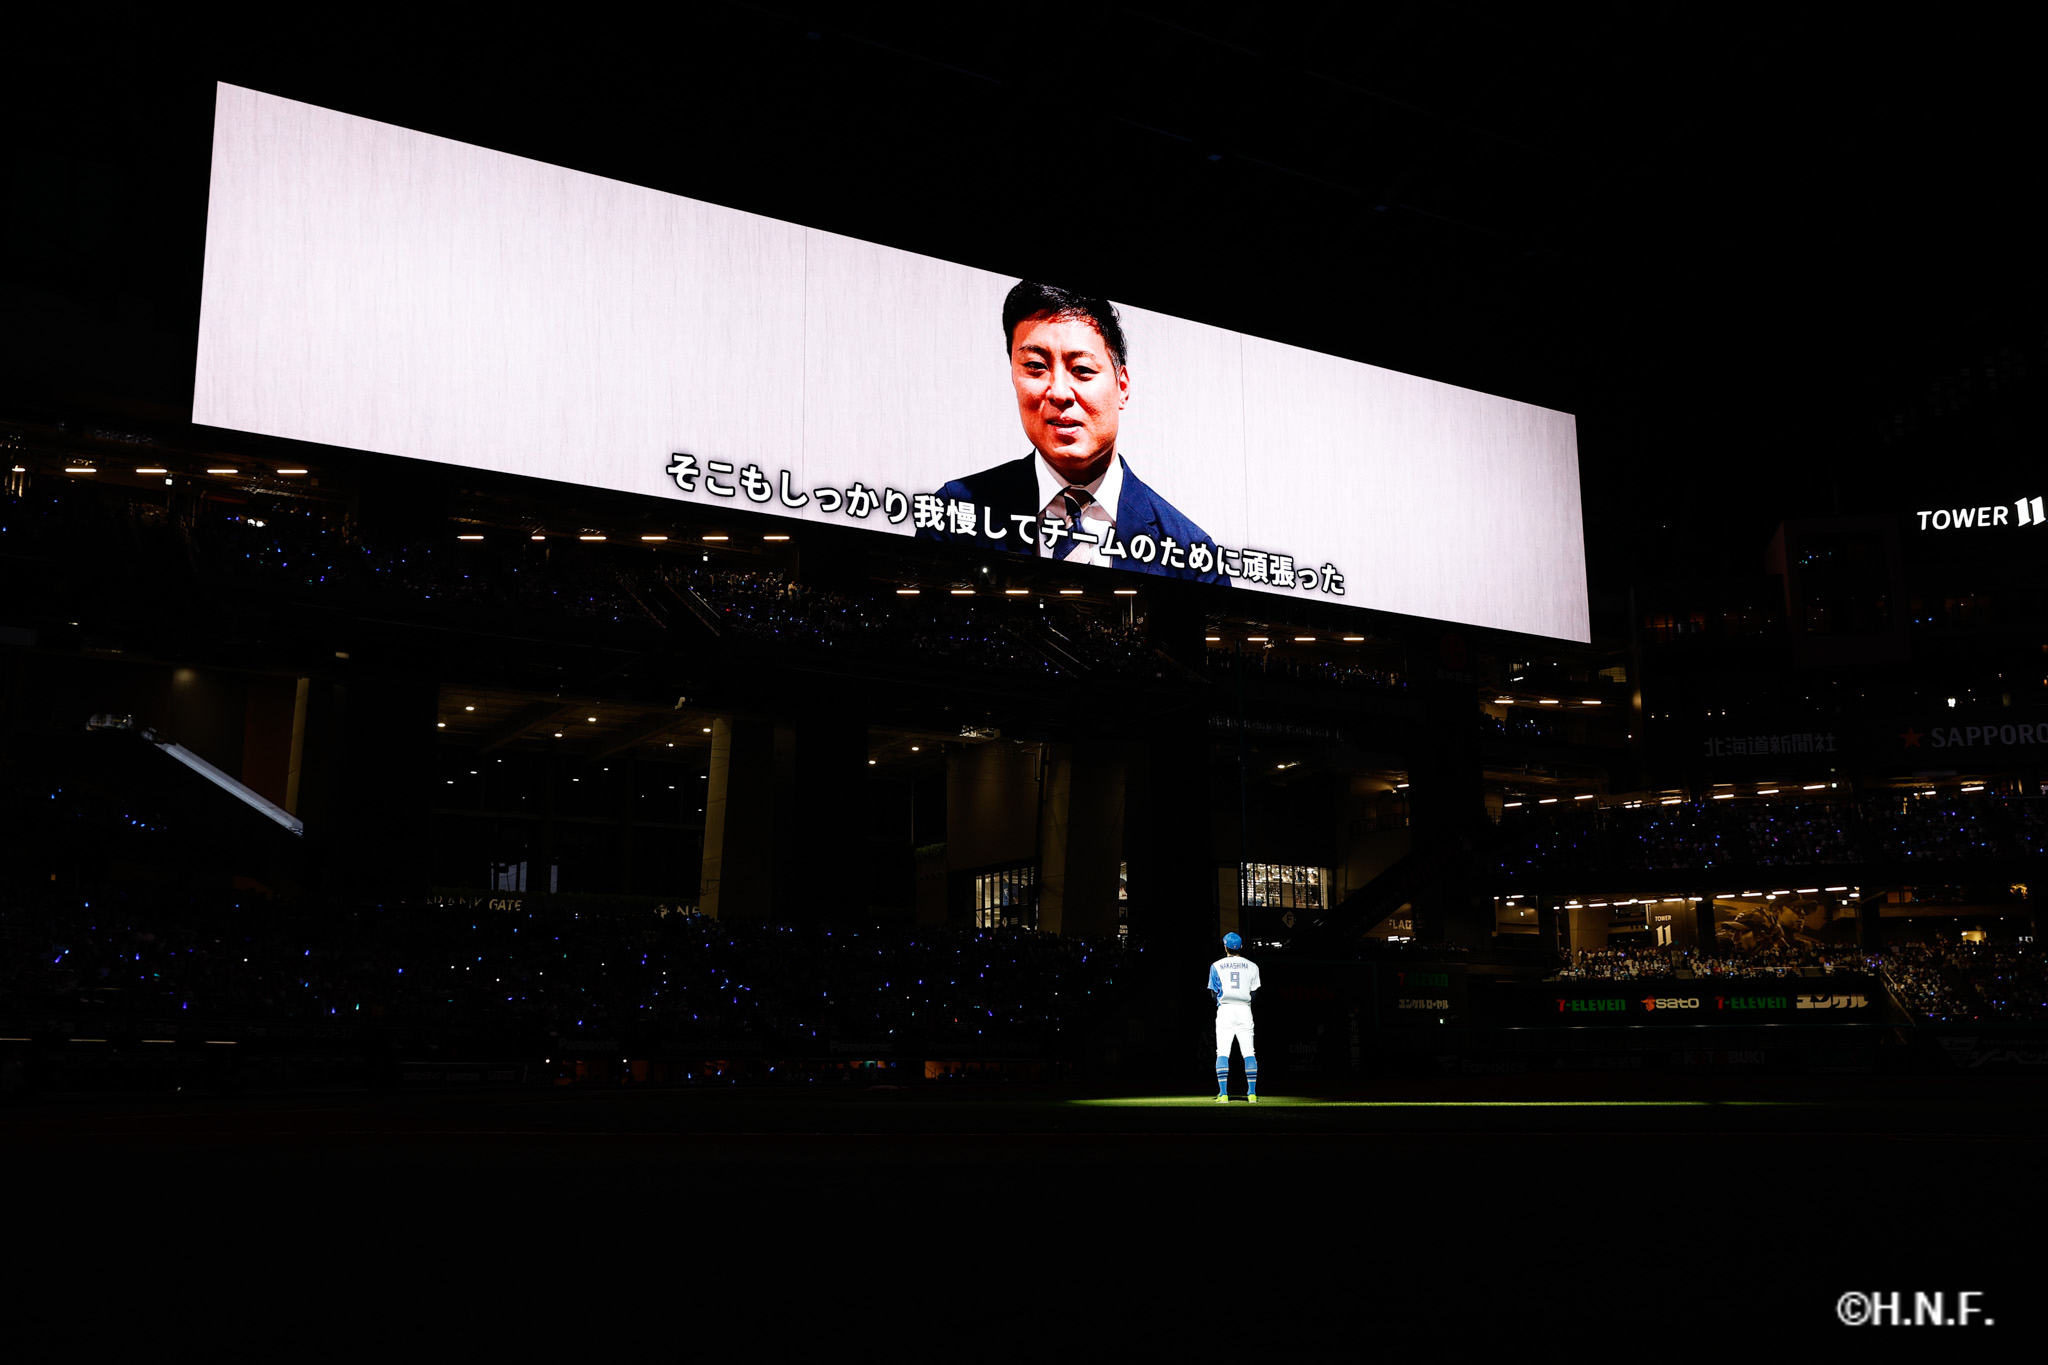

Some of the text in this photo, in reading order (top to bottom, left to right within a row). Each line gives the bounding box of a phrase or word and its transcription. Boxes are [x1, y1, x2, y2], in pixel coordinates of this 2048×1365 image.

[665, 452, 1346, 597] そこもしっかり我慢してチームのために頑張った
[1917, 496, 2047, 530] TOWER 11
[1704, 732, 1837, 758] 北海道新聞社
[1931, 722, 2048, 748] SAPPORO
[488, 898, 522, 911] GATE
[1656, 924, 1673, 947] 11
[1230, 971, 1241, 989] 9
[1796, 993, 1869, 1009] ユンケル
